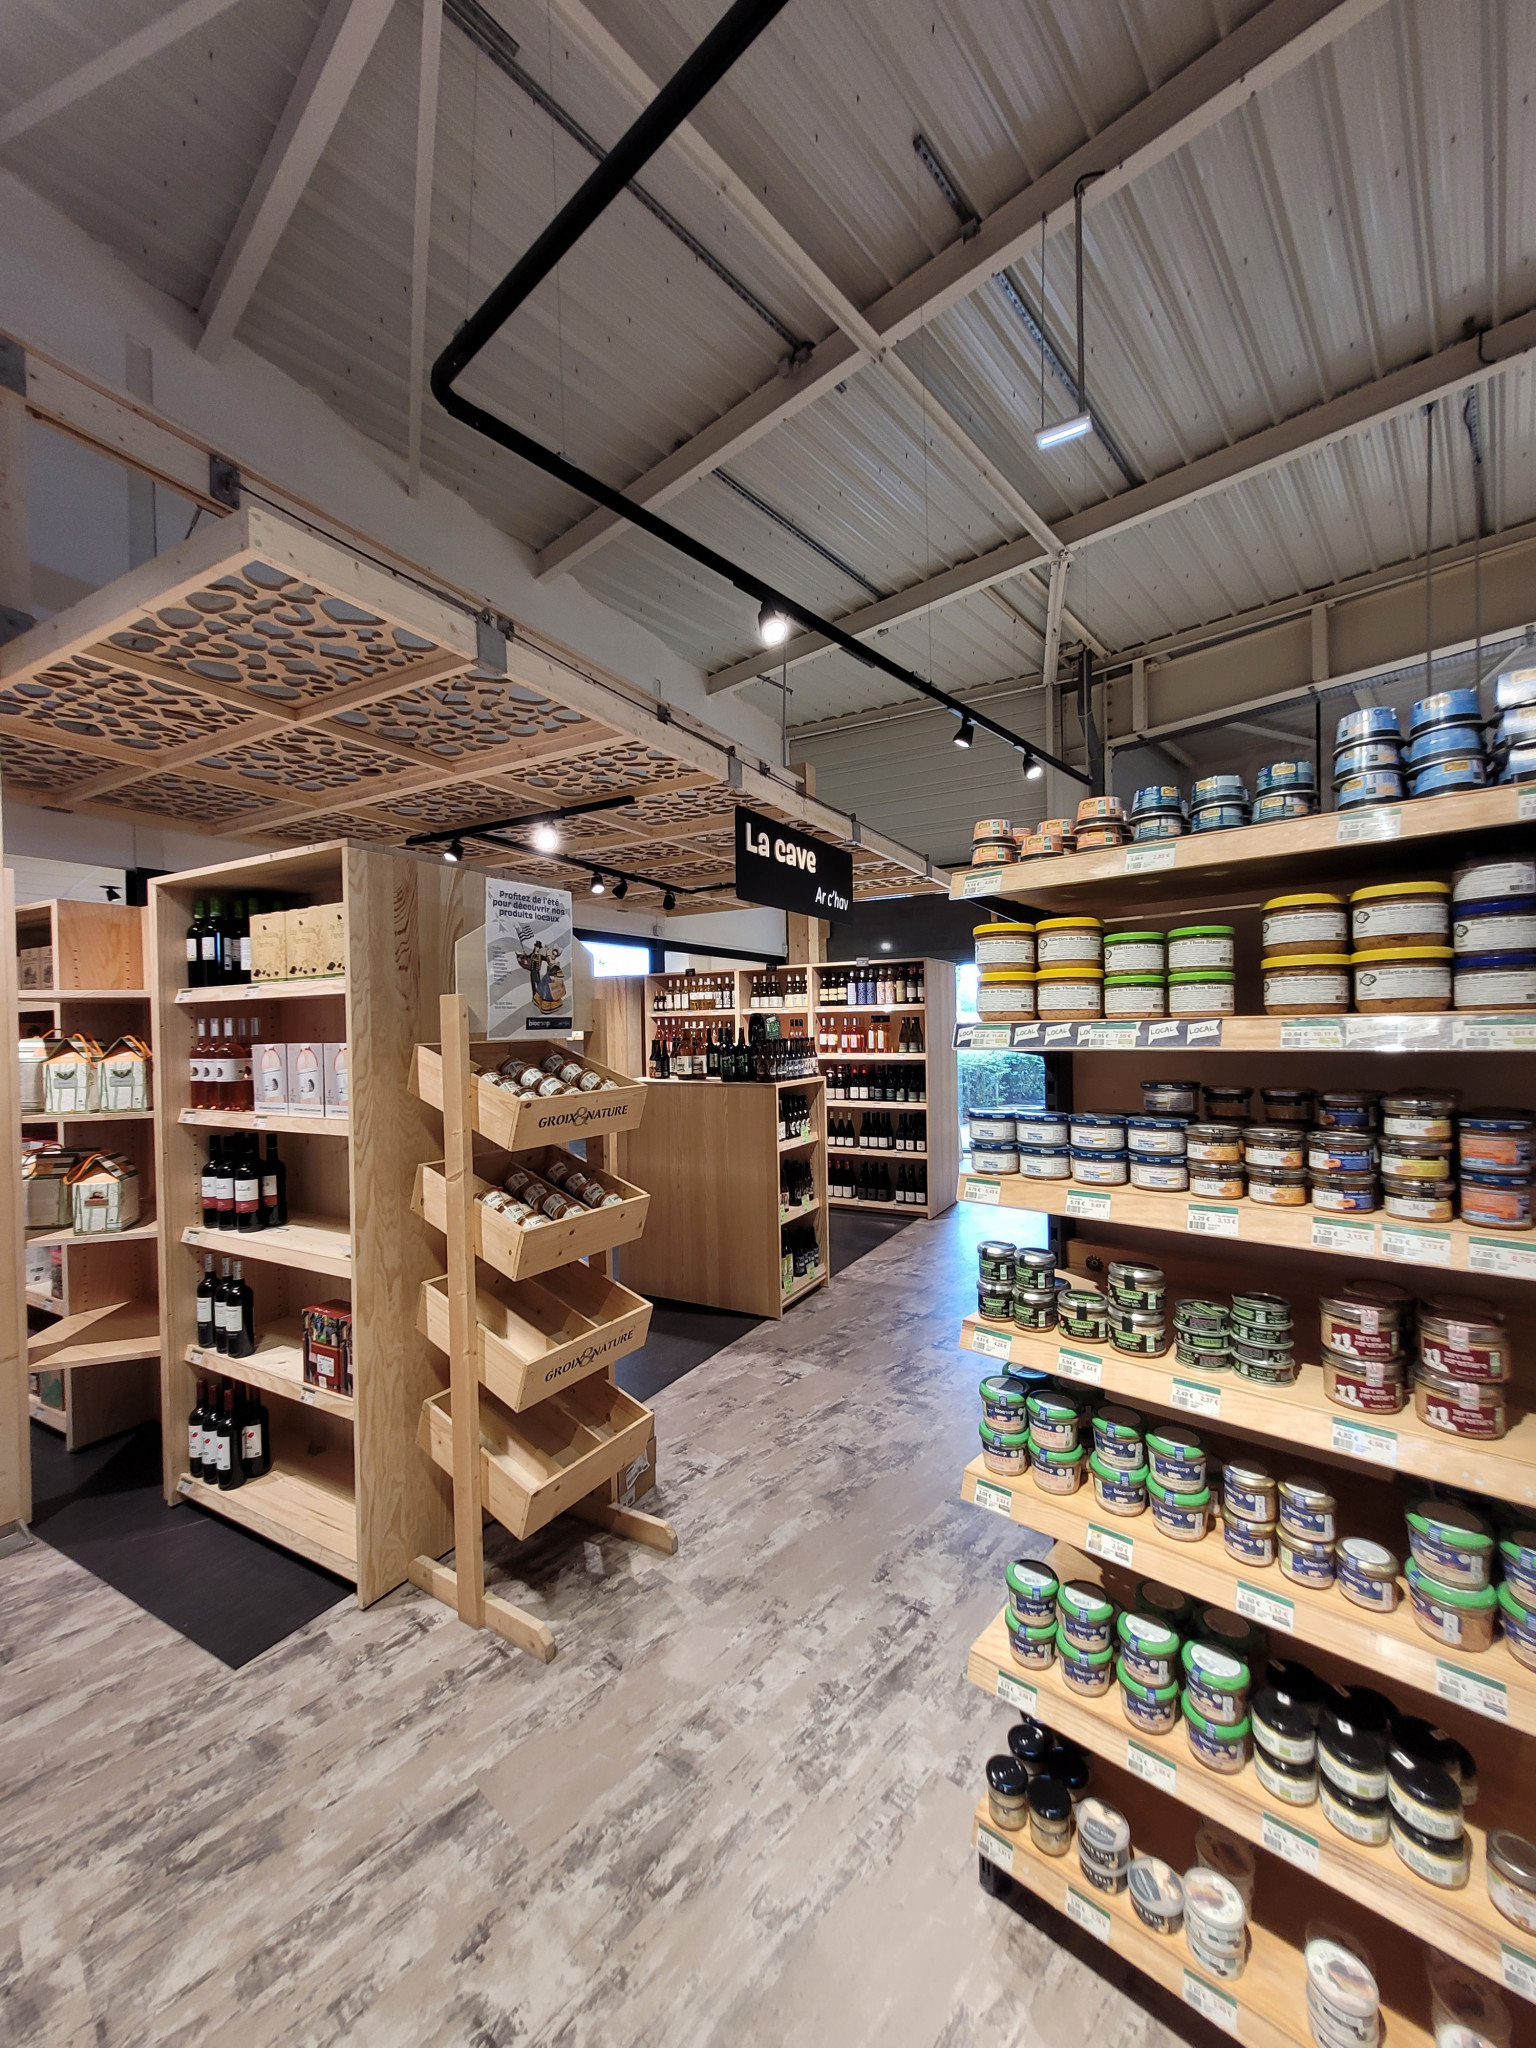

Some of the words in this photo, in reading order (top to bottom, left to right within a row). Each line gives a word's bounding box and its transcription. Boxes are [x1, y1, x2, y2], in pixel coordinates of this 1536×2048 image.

[745, 822, 770, 858] La
[774, 839, 817, 874] cave
[500, 890, 530, 902] Profitez
[532, 895, 542, 904] de
[543, 897, 559, 906] l'été
[815, 887, 827, 905] Ar
[492, 899, 512, 908] pour
[513, 900, 550, 914] découvrir
[552, 907, 565, 916] nos
[499, 909, 533, 920] produits
[534, 912, 560, 922] locaux
[1016, 1028, 1036, 1037] LOCAL
[1046, 1028, 1068, 1036] LOCAL
[1150, 1026, 1174, 1036] LOCAL
[1190, 1025, 1214, 1034] LOCAL
[538, 1112, 578, 1128] GROIX
[586, 1104, 628, 1120] NATURE
[545, 1356, 582, 1382] GROIX
[592, 1330, 634, 1356] NATURE
[1166, 1462, 1190, 1474] biocoop
[1114, 1488, 1136, 1497] biocoop
